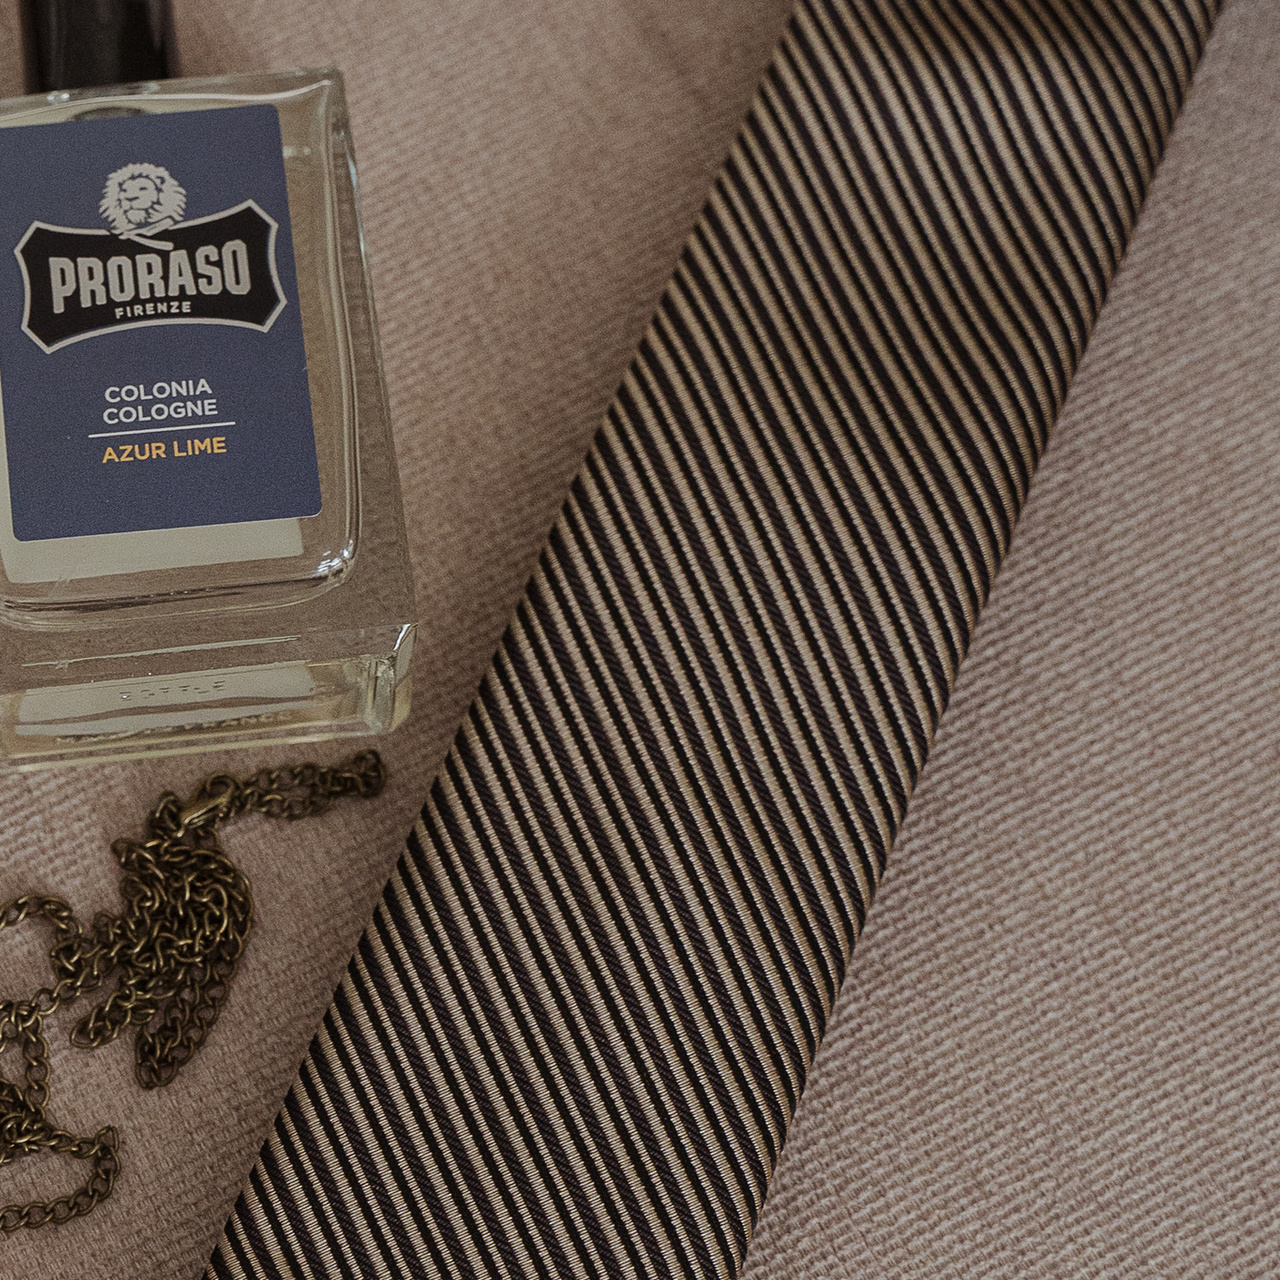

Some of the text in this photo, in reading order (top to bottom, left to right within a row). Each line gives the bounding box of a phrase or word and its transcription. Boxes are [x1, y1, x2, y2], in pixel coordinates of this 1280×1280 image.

[48, 239, 252, 314] PRORASO
[115, 301, 192, 319] FIRENZE
[104, 378, 213, 404] COLONIA
[102, 399, 219, 425] COLOGNE
[102, 436, 227, 464] AZUR LIME
